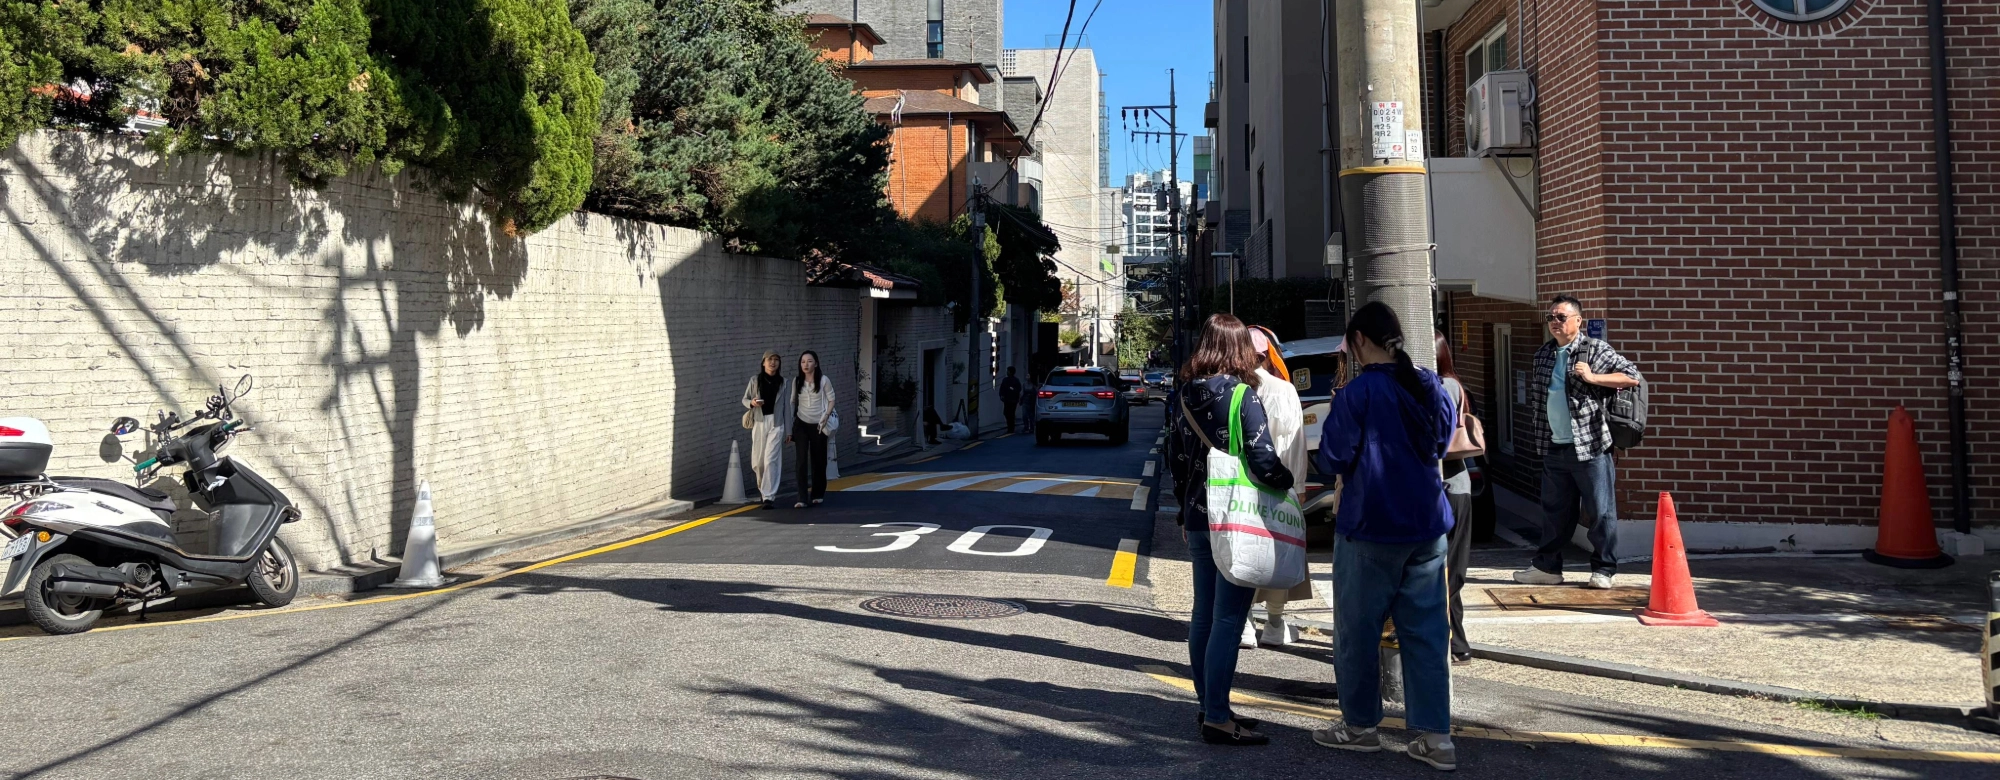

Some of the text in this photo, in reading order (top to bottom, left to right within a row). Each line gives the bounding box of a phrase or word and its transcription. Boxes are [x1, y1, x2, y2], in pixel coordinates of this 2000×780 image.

[1229, 500, 1267, 517] OLIVE
[813, 521, 1054, 557] 30
[1334, 729, 1350, 743] N
[1418, 741, 1427, 754] N
